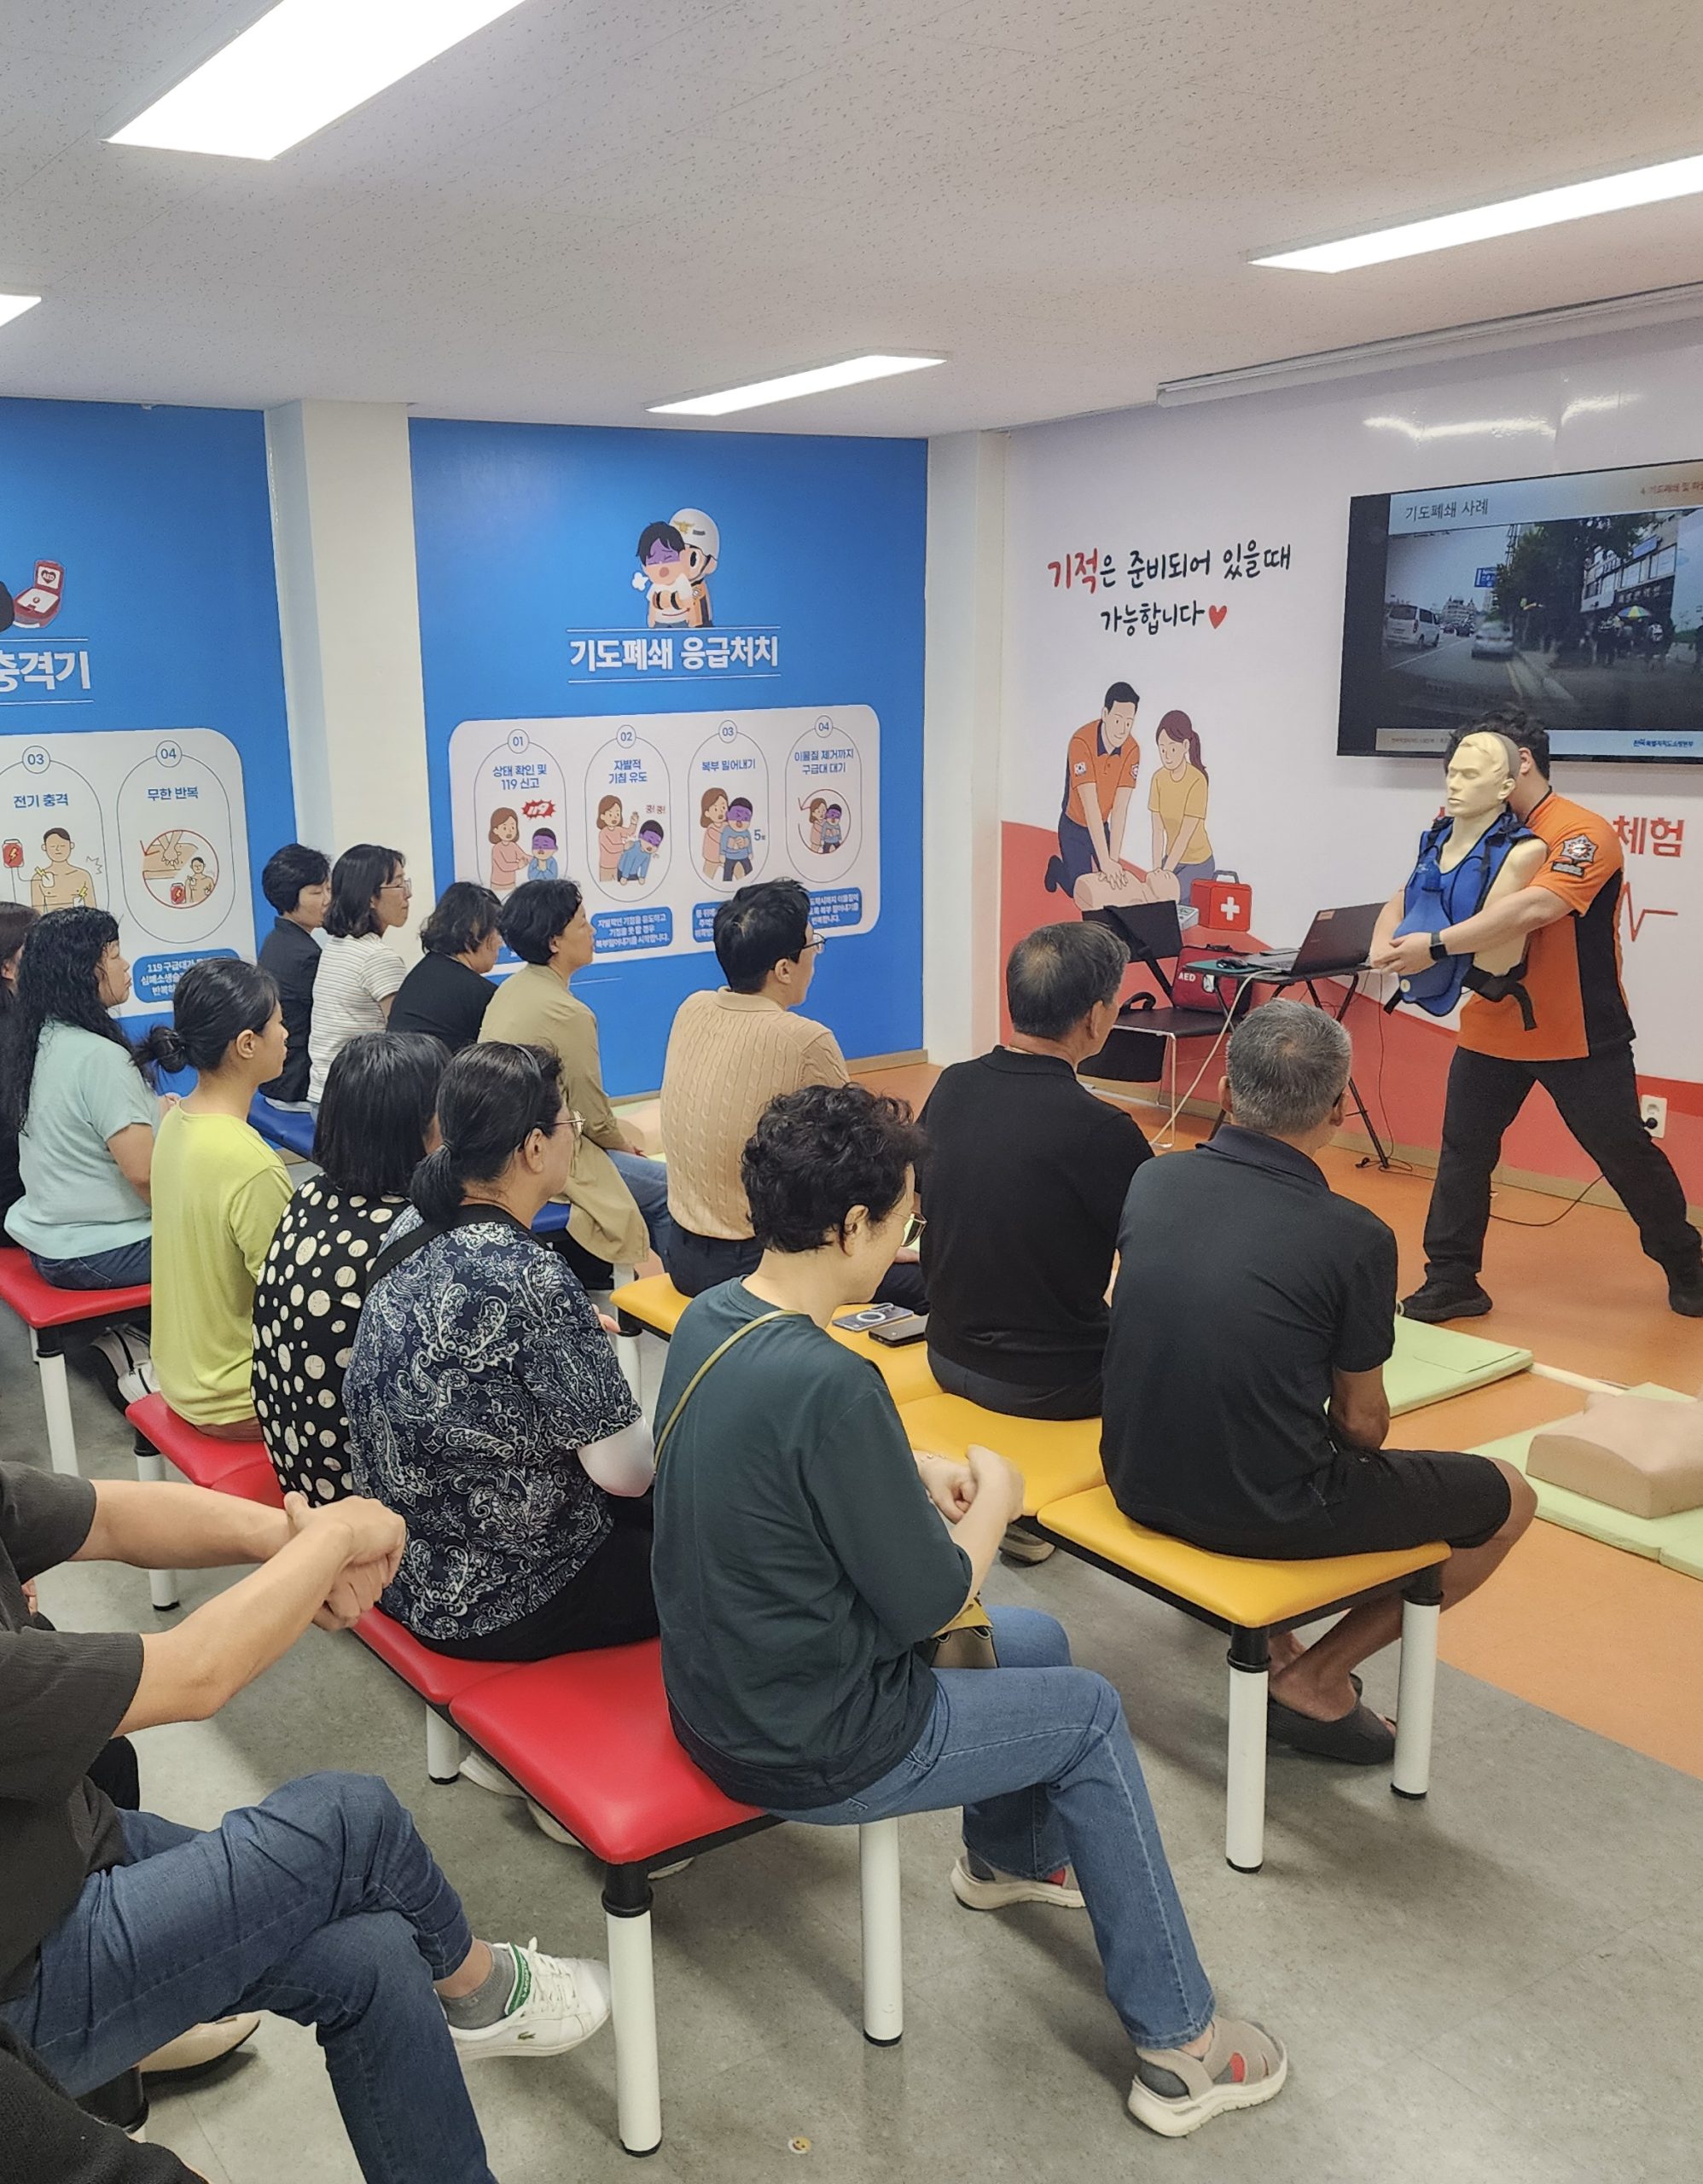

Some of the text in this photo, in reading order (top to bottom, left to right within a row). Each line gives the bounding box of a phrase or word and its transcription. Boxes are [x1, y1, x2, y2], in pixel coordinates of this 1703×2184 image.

[1405, 498, 1489, 522] 기도폐쇄 사례
[1047, 539, 1291, 594] 기적은 준비되어 있을때
[1101, 600, 1206, 636] 가능합니다
[570, 636, 778, 672] 기도폐쇄 응급처치
[722, 727, 734, 736] 03
[818, 722, 829, 731] 04
[512, 736, 523, 746] 01
[620, 732, 632, 741] 02
[27, 753, 44, 765] 03
[160, 748, 177, 759] 04
[794, 748, 854, 761] 이물질 제거까지
[492, 764, 547, 777] 상태 확인 및
[614, 759, 642, 770] 자발적
[701, 758, 756, 772] 복부 밀어내기
[802, 762, 846, 775] 구급대 대기
[501, 778, 539, 790] 119 신고
[608, 771, 648, 784] 기침 유도
[14, 793, 68, 808] 전기 충격
[148, 787, 199, 801] 무한 반복
[527, 803, 549, 816] 119
[1613, 815, 1684, 857] 체험
[148, 962, 163, 973] 119
[141, 973, 183, 986] 심폐소생술
[1178, 972, 1196, 982] AED
